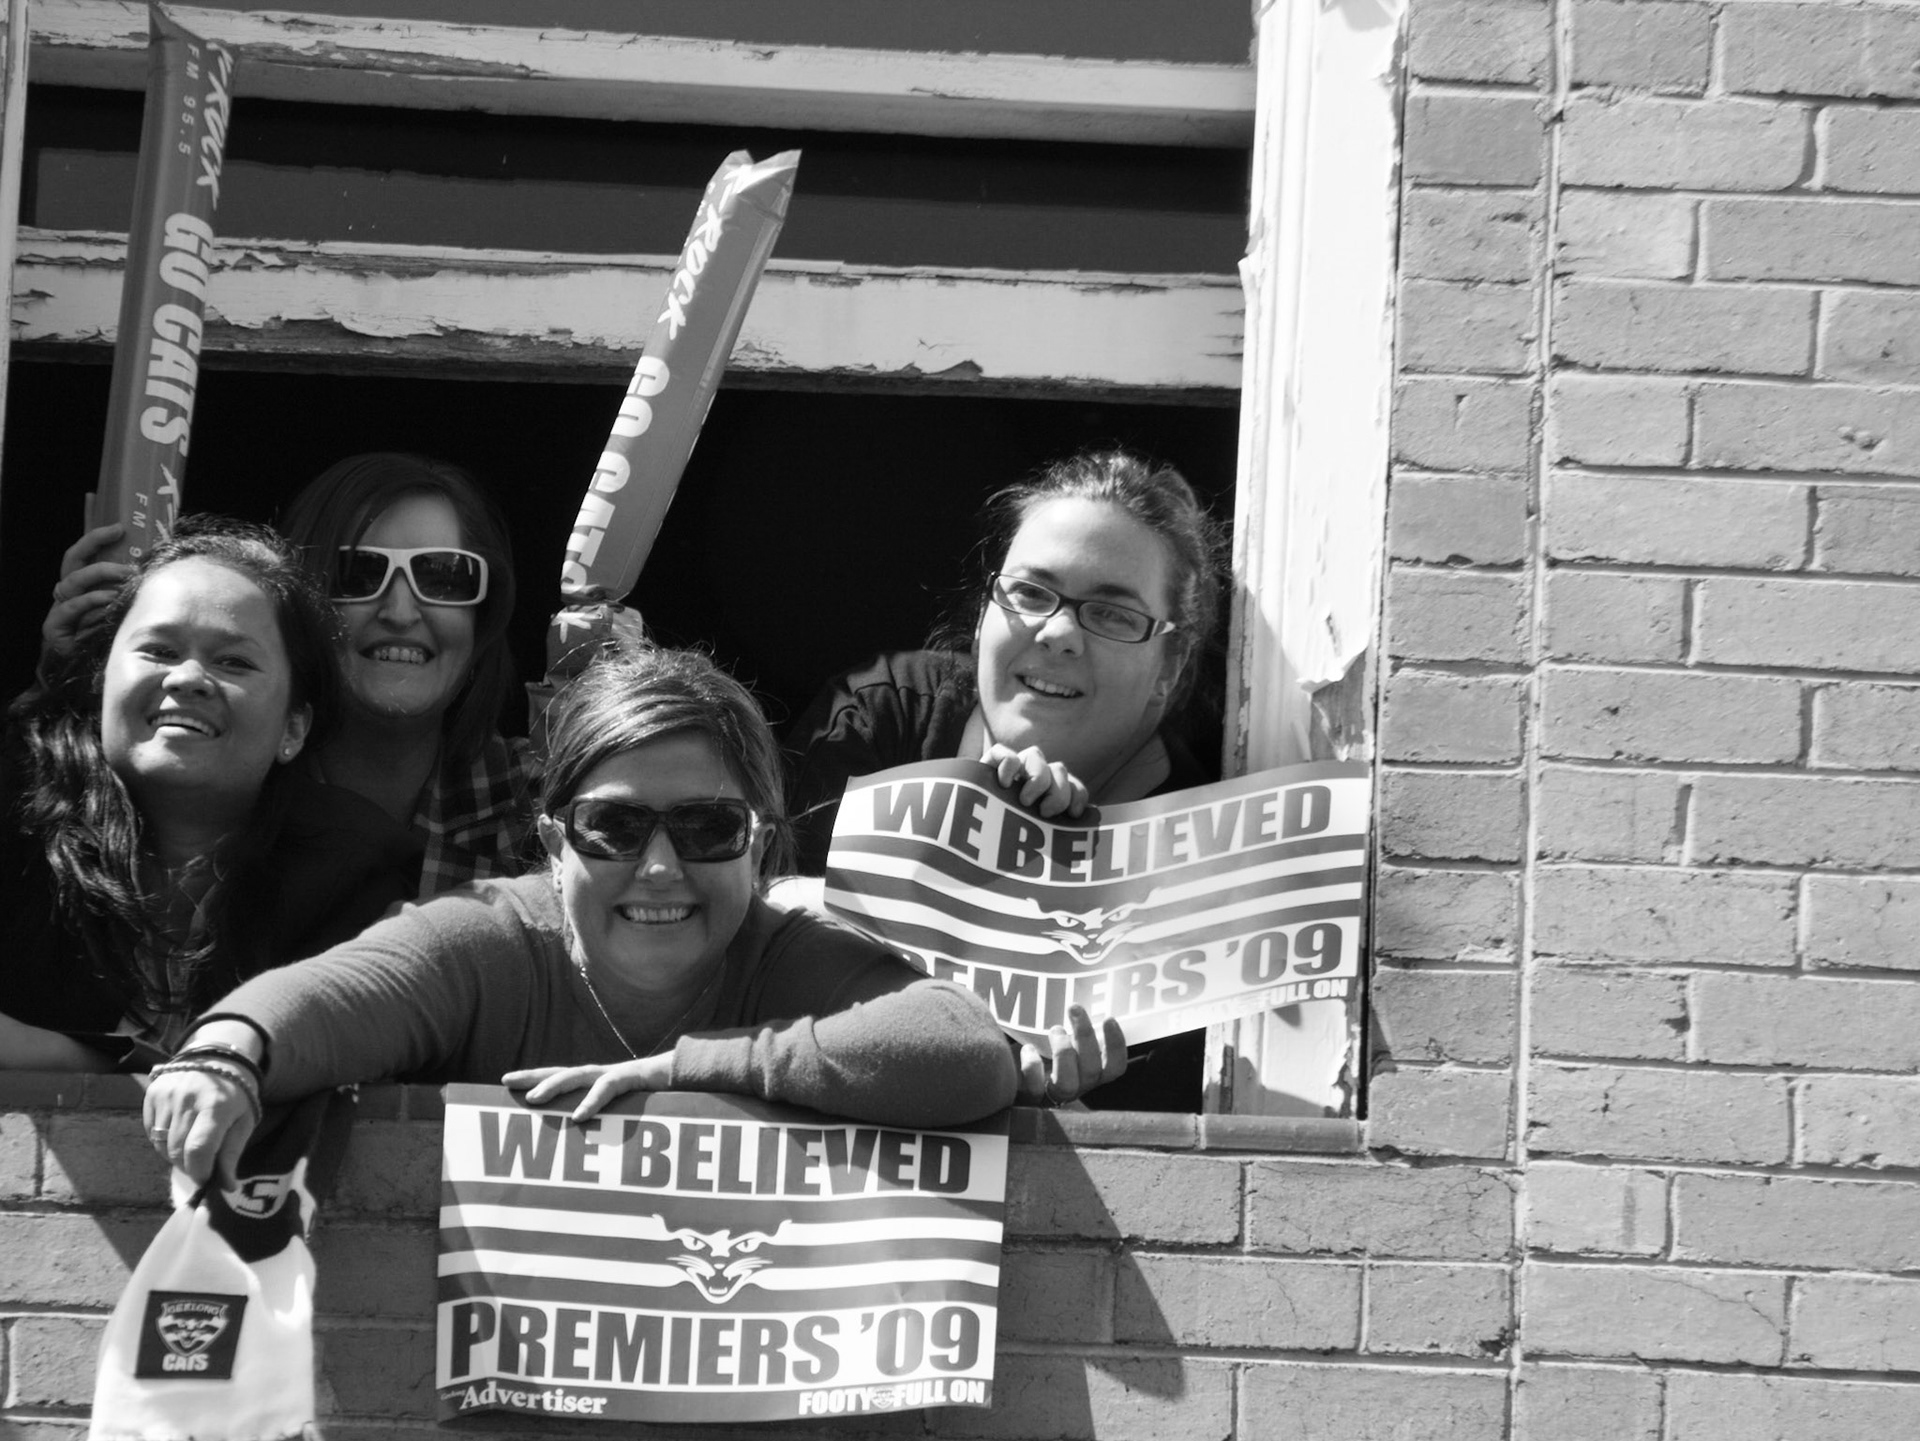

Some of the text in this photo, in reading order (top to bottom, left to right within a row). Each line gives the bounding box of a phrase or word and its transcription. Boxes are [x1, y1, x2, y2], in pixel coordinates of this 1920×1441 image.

[178, 43, 200, 155] FM 95.5
[159, 212, 214, 302] GO
[140, 303, 203, 457] CATS
[872, 781, 1332, 882] WE BELIEVED
[1313, 978, 1349, 999] ON
[478, 1110, 972, 1196] WE BELIEVED
[162, 1352, 209, 1372] CATS
[449, 1301, 841, 1387] PREMIERS
[458, 1380, 608, 1414] Advertiser
[798, 1378, 986, 1415] FOOTY FULL ON
